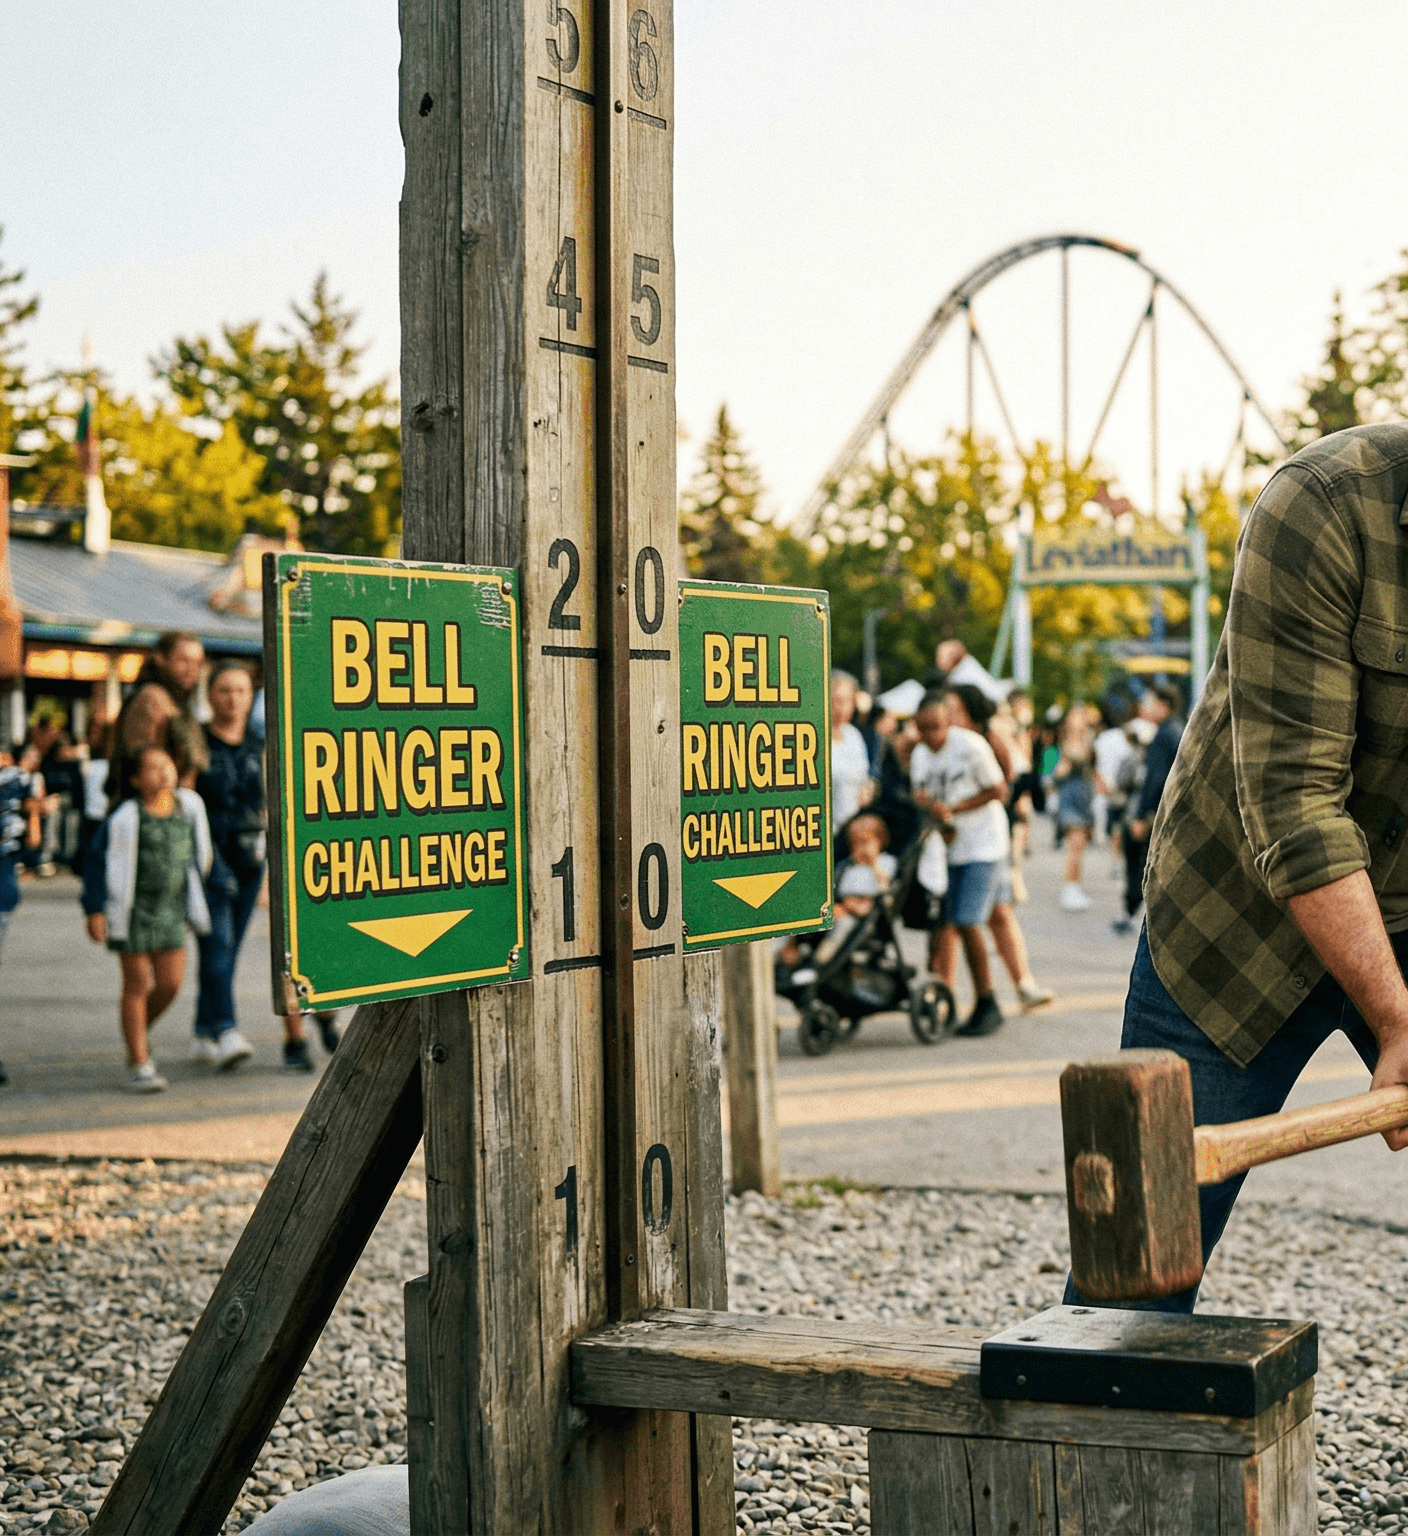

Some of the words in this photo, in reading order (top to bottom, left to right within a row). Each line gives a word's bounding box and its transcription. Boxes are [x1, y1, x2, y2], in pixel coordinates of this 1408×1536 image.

[330, 617, 477, 709] BELL
[703, 631, 800, 707] BELL
[302, 726, 507, 820] RINGER
[681, 721, 820, 796] RINGER
[302, 829, 508, 898] CHALLENGE
[681, 804, 822, 863] CHALLENGE
